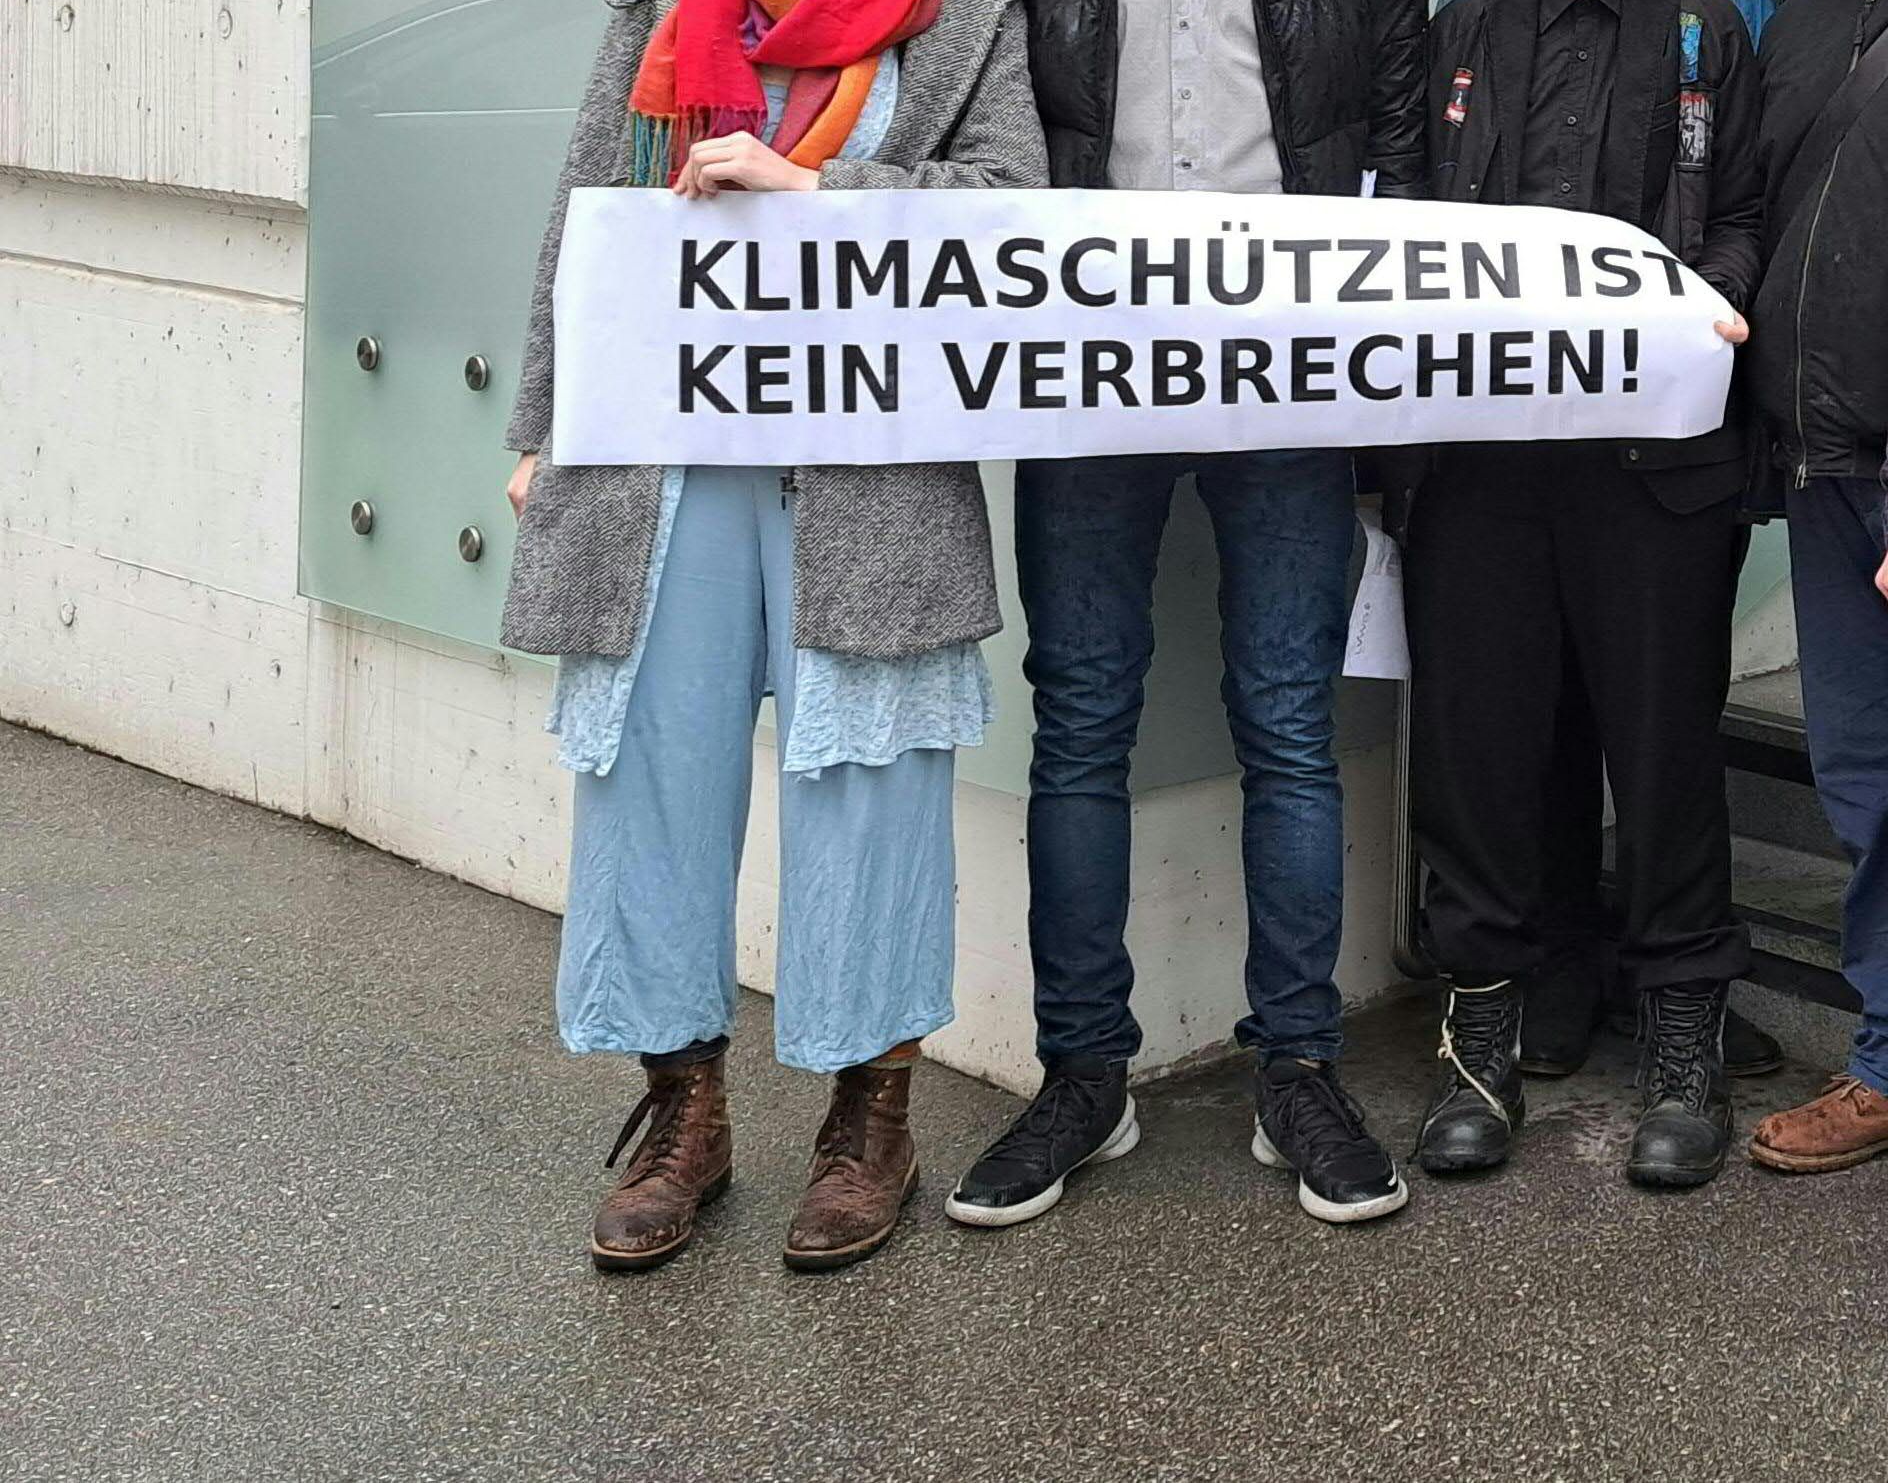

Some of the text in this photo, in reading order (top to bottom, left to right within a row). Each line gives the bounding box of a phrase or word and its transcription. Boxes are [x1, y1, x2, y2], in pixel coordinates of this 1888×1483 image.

[679, 221, 1687, 311] KLIMASCHÜTZEN IST
[678, 327, 1640, 415] KEIN VERBRECHEN!
